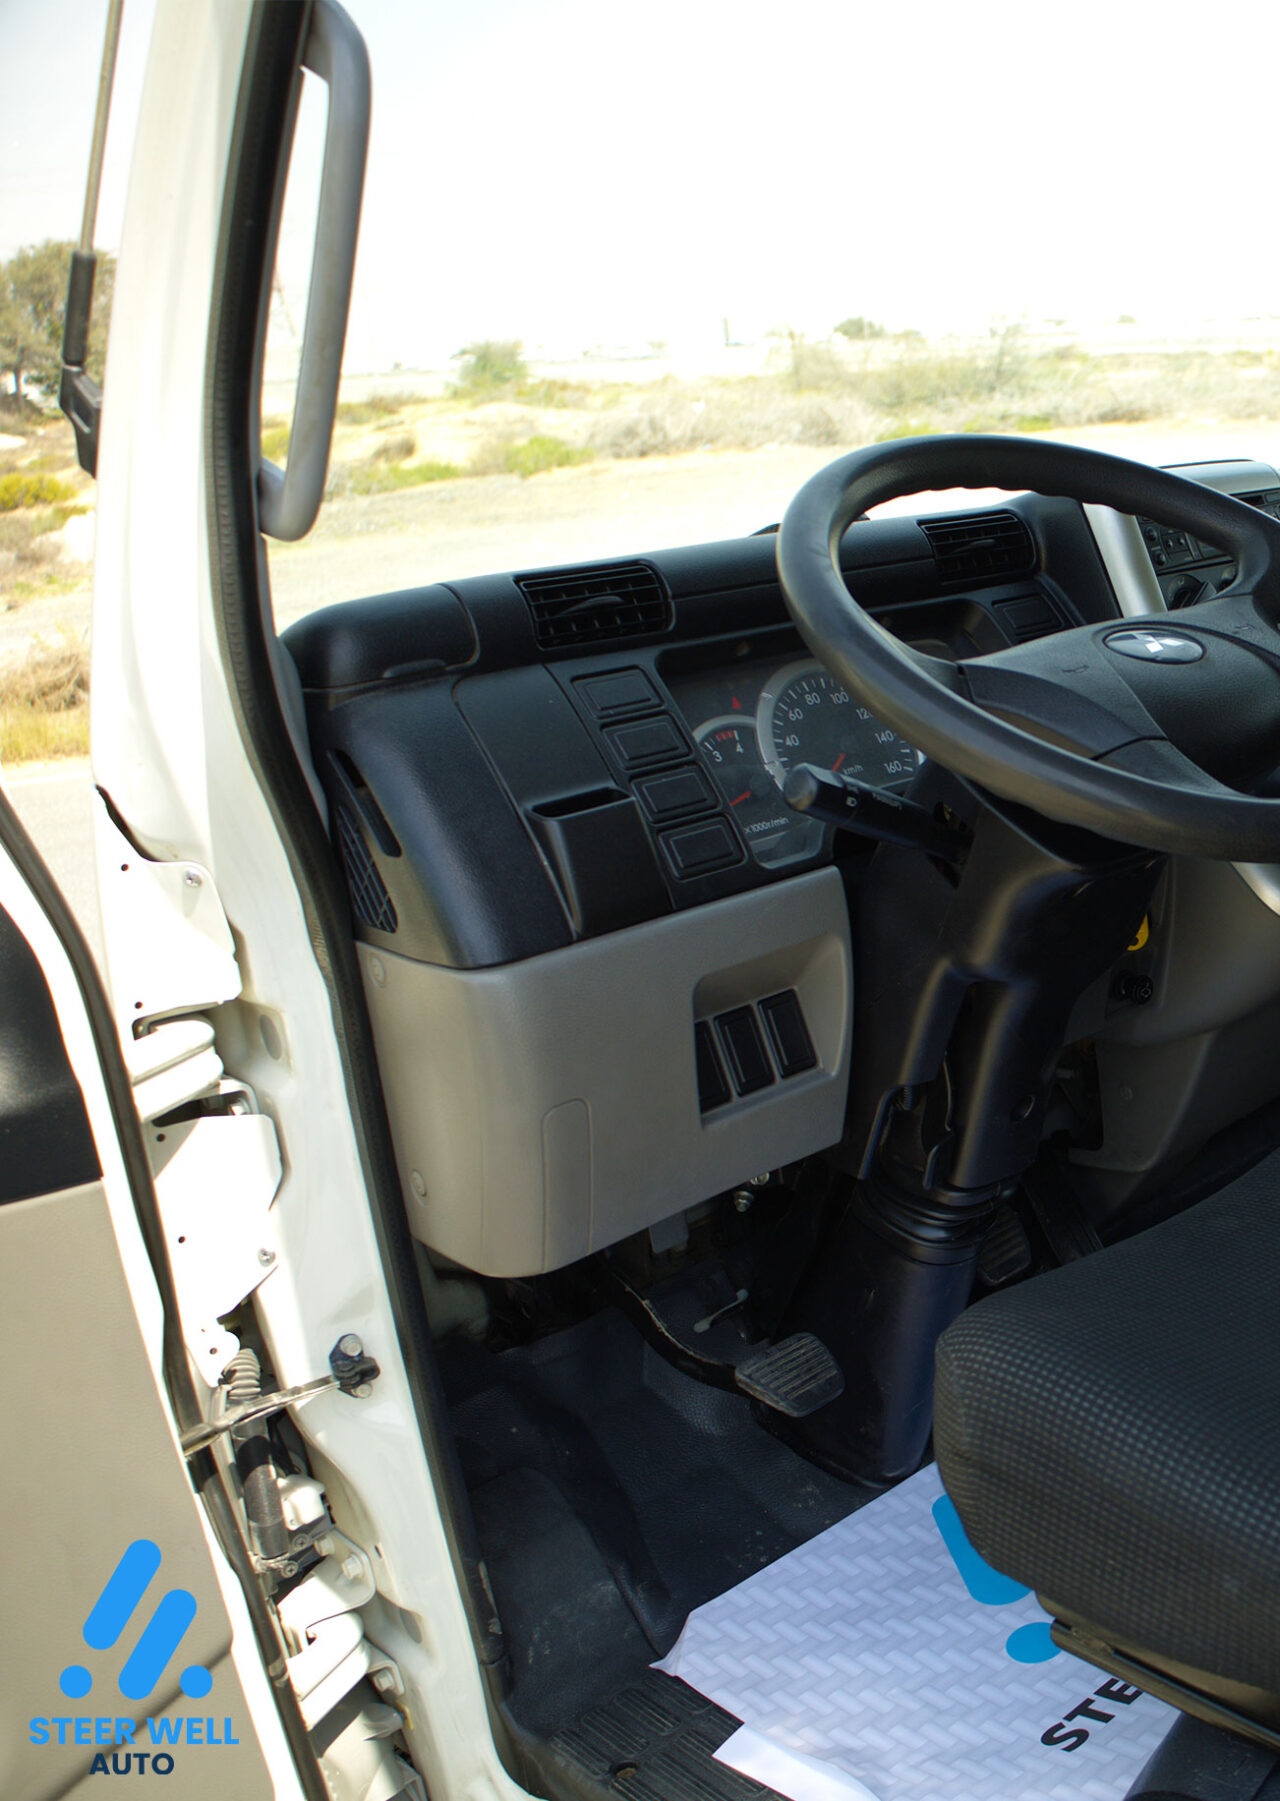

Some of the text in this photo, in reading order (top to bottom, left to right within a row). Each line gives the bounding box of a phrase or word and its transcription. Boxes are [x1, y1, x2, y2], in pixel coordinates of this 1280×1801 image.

[804, 692, 821, 705] 80
[830, 691, 849, 705] 100
[788, 708, 804, 721] 60
[785, 735, 799, 747] 40
[875, 731, 895, 745] 140
[736, 743, 744, 754] 4
[712, 751, 723, 762] 3
[884, 759, 902, 774] 160
[1041, 1677, 1143, 1752] STE
